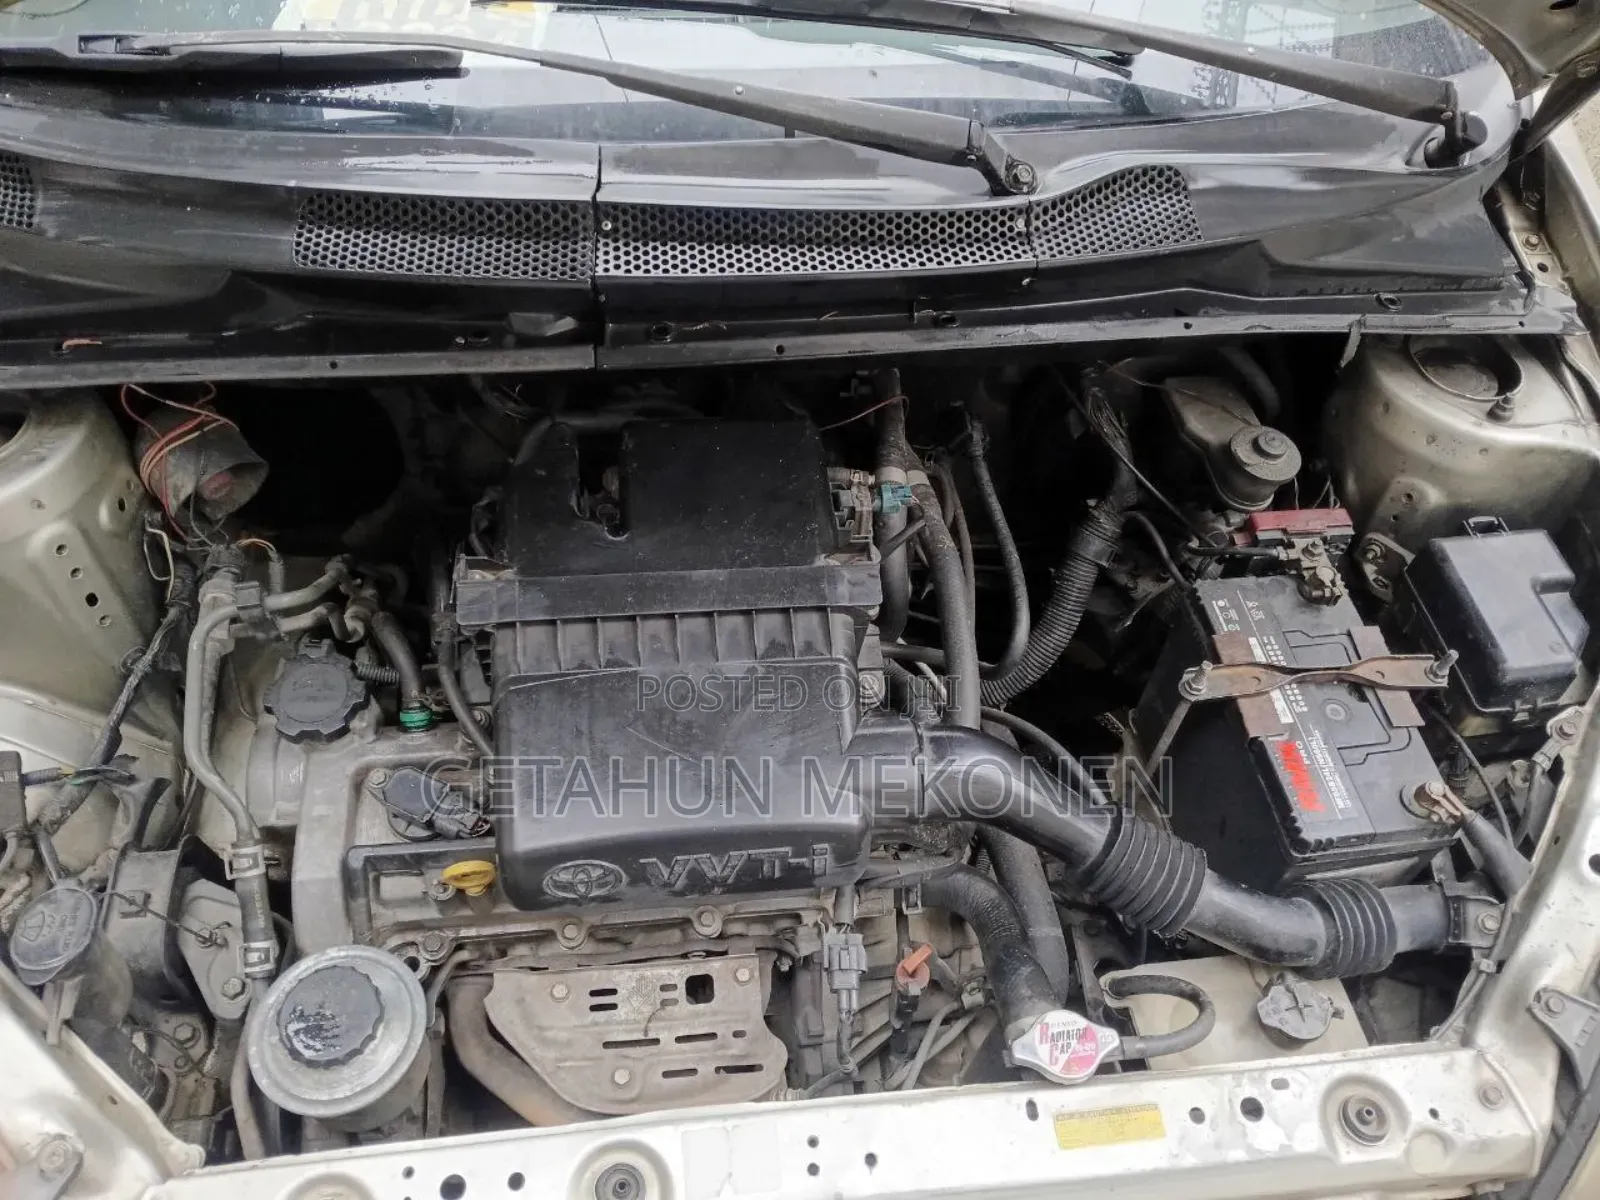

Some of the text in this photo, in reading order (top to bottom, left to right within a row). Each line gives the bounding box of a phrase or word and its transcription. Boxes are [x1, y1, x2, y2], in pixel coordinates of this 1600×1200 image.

[1296, 741, 1311, 765] PRO
[639, 843, 831, 894] VVT-i
[1039, 1022, 1088, 1045] RADIATOR
[1049, 1041, 1073, 1067] CAP
